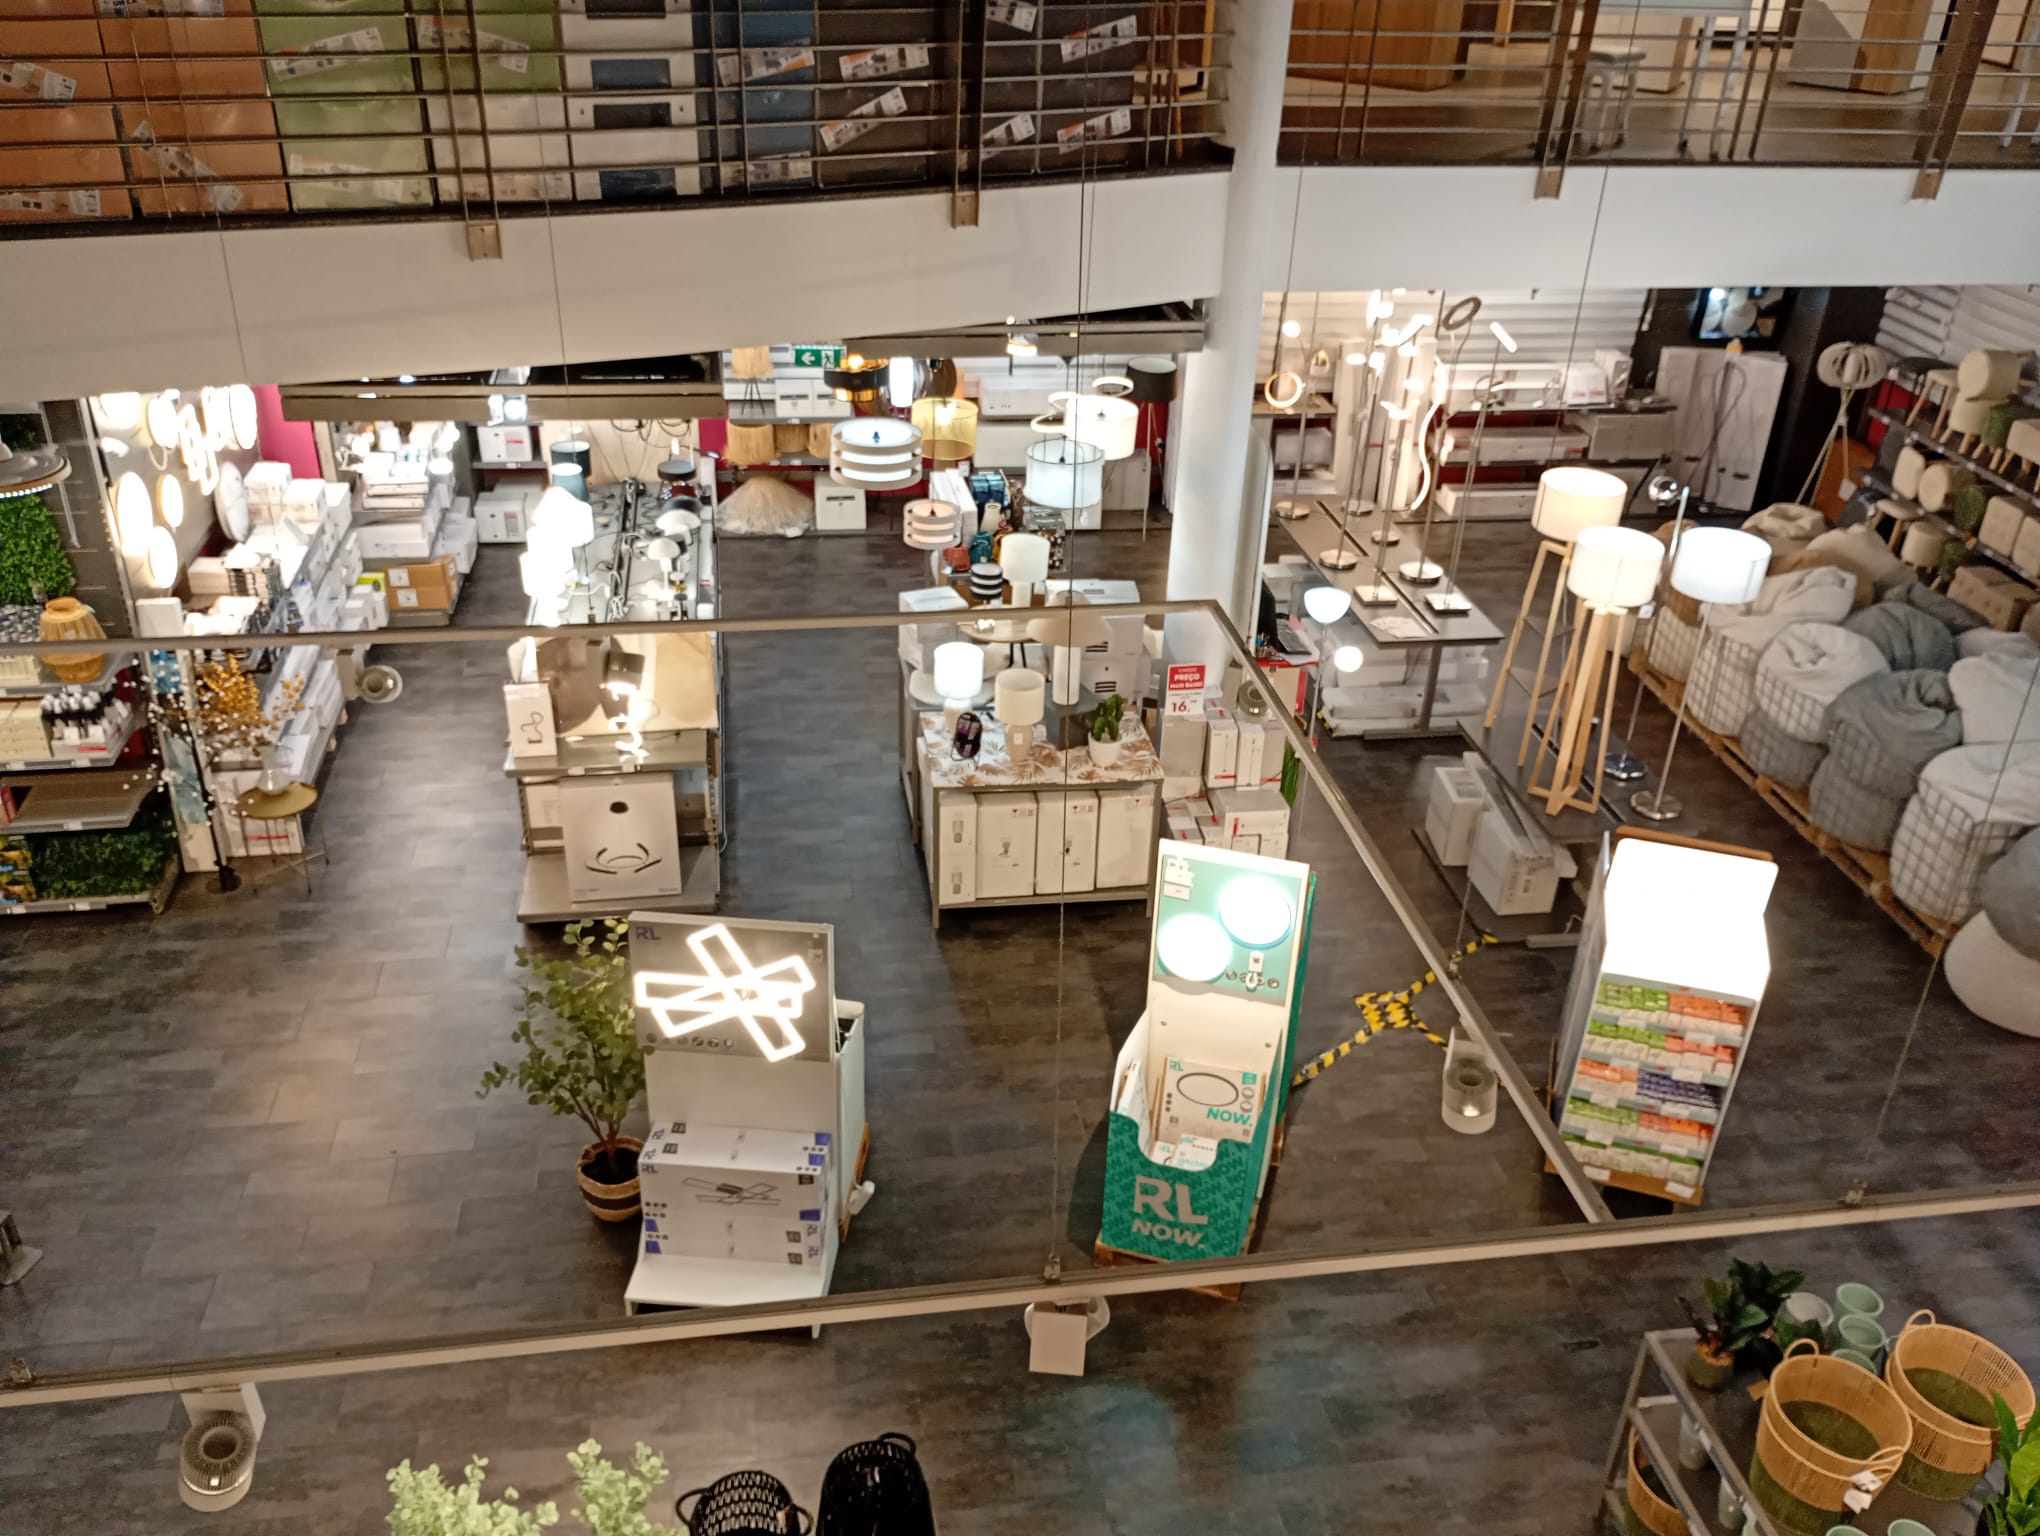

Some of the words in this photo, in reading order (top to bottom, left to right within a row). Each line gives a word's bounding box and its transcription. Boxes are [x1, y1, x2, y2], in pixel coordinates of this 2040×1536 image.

[1174, 673, 1201, 682] PREÇO
[636, 926, 662, 941] RL
[1169, 1060, 1184, 1072] RL
[1132, 1174, 1209, 1225] RL
